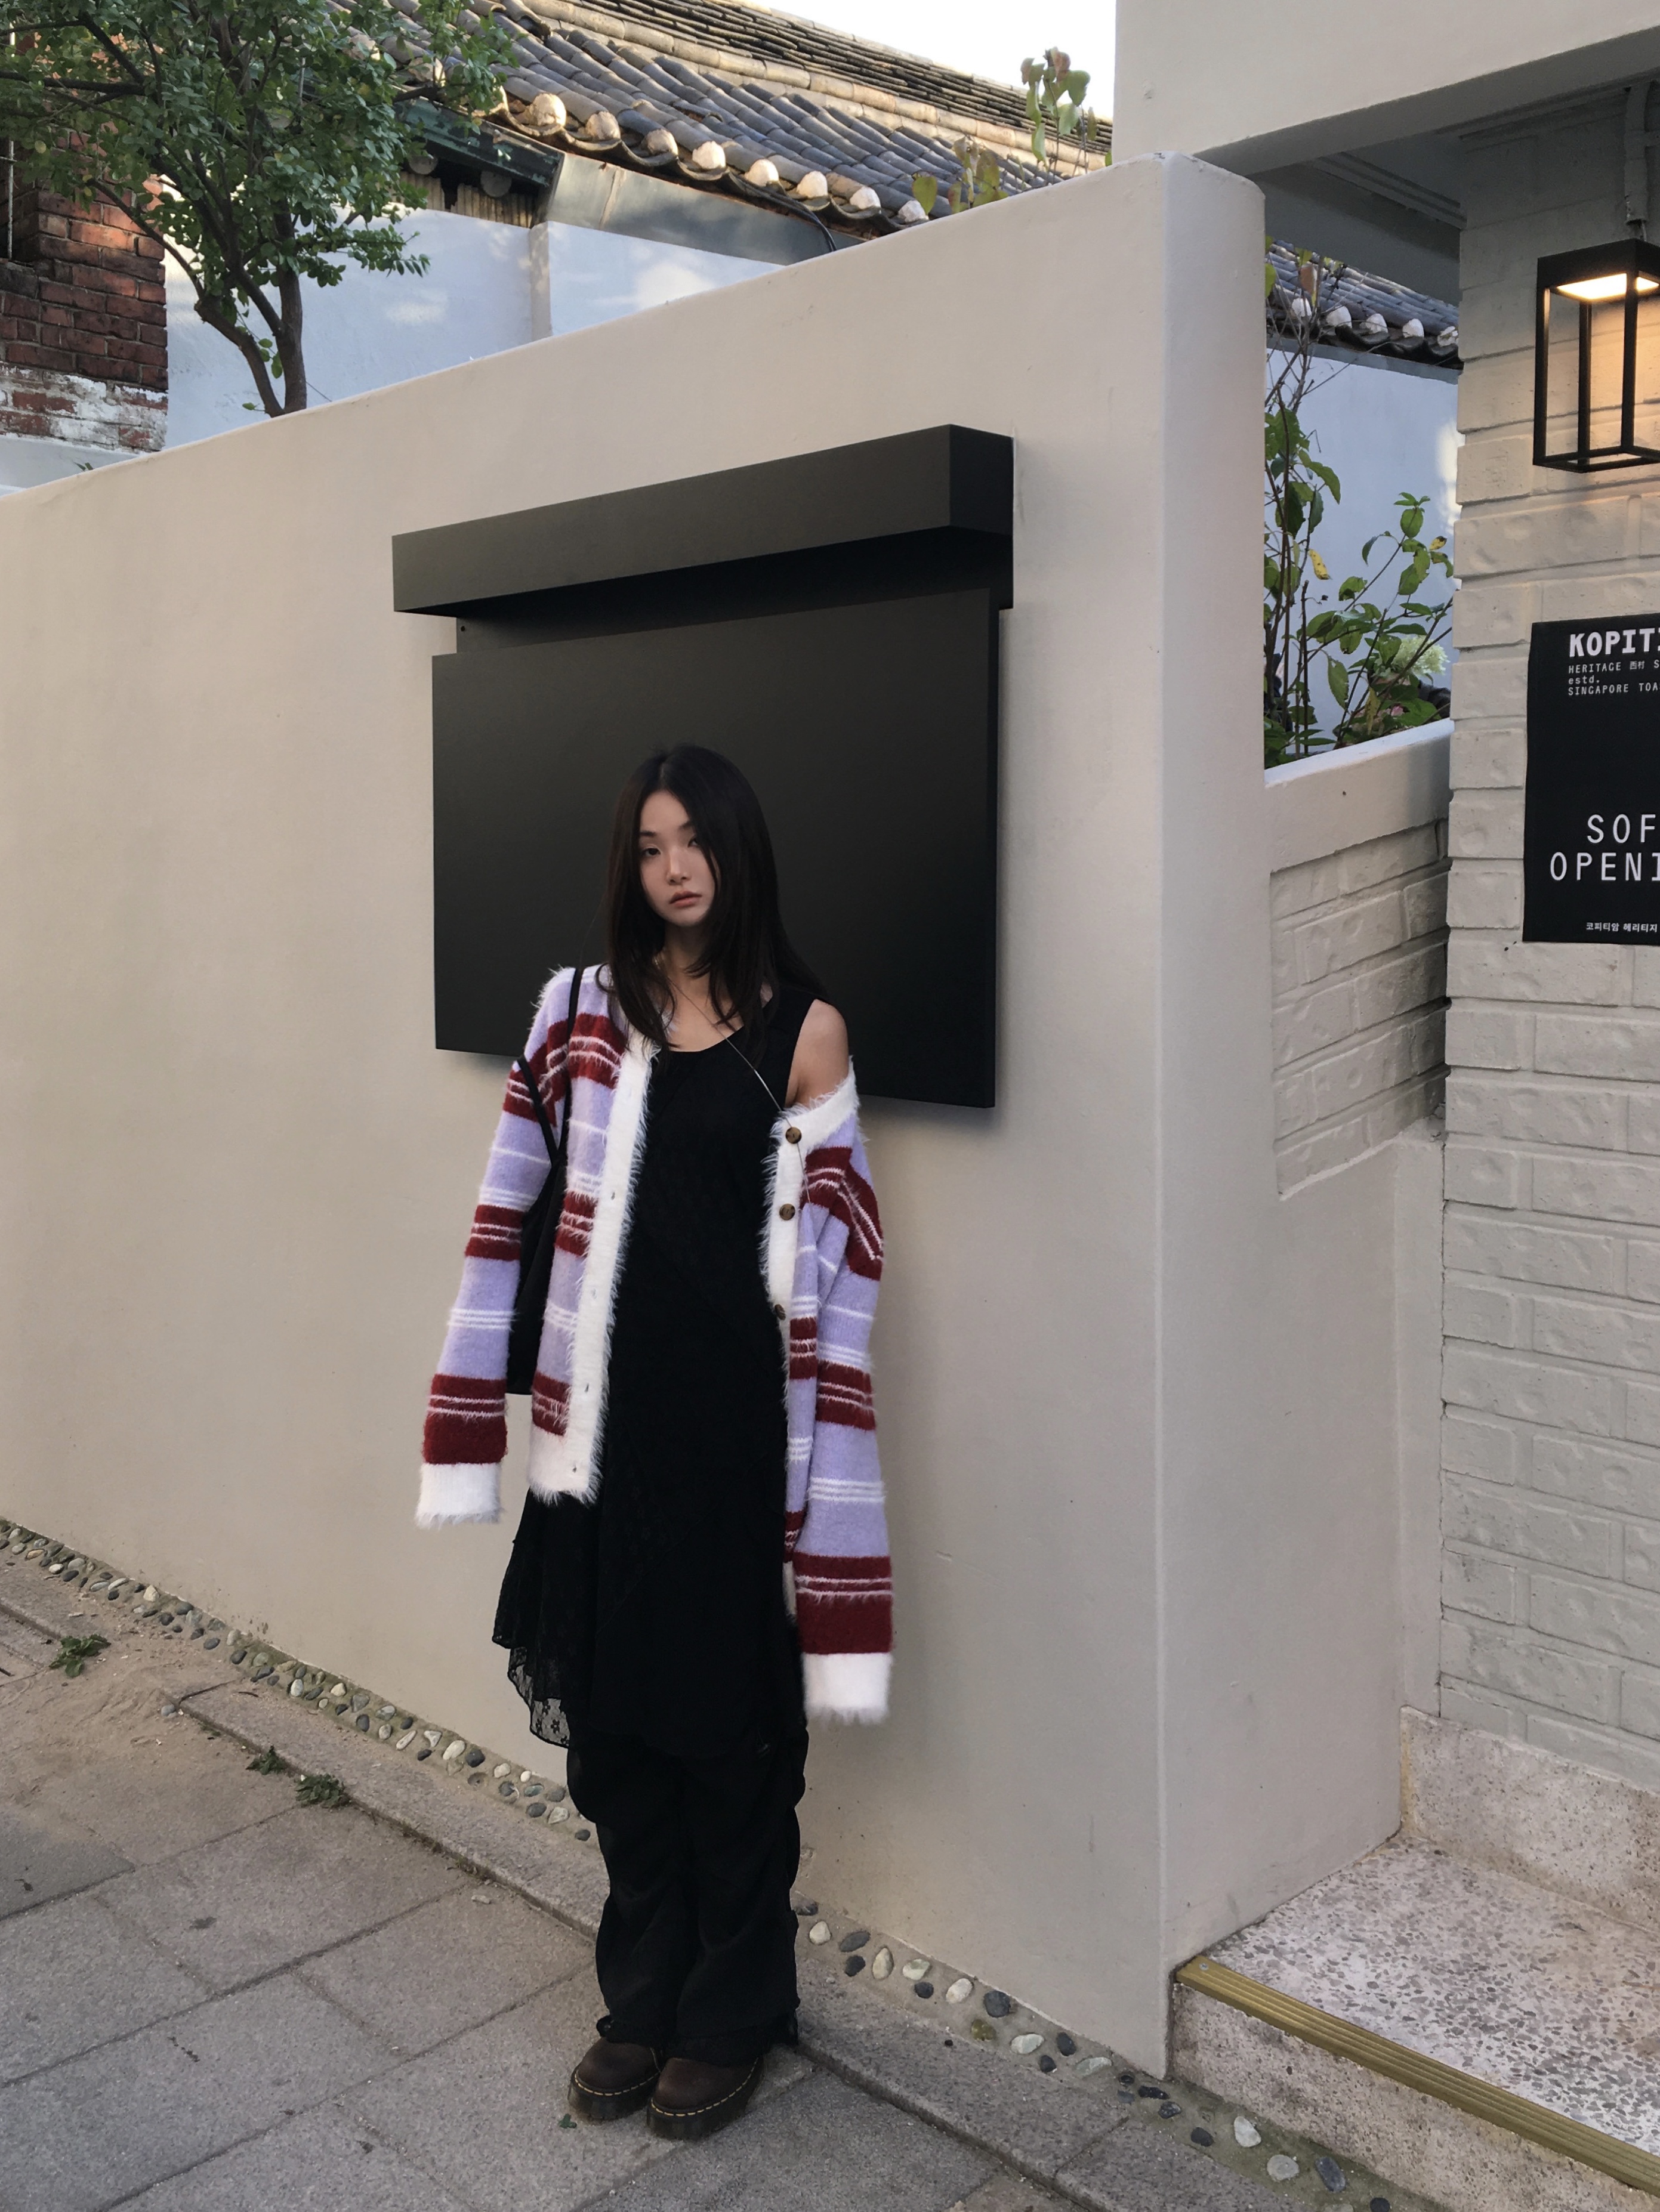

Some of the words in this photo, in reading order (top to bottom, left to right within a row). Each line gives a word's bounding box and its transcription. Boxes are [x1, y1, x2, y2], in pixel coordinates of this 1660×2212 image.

[1569, 627, 1660, 657] KOPIT
[1568, 662, 1621, 674] HERITAGE
[1568, 675, 1600, 684] estd.
[1568, 684, 1629, 696] SINGAPORE
[1639, 682, 1660, 692] TOA
[1587, 814, 1656, 844] SOF
[1586, 922, 1619, 932] 코피티암
[1623, 923, 1658, 932] 헤리티지
